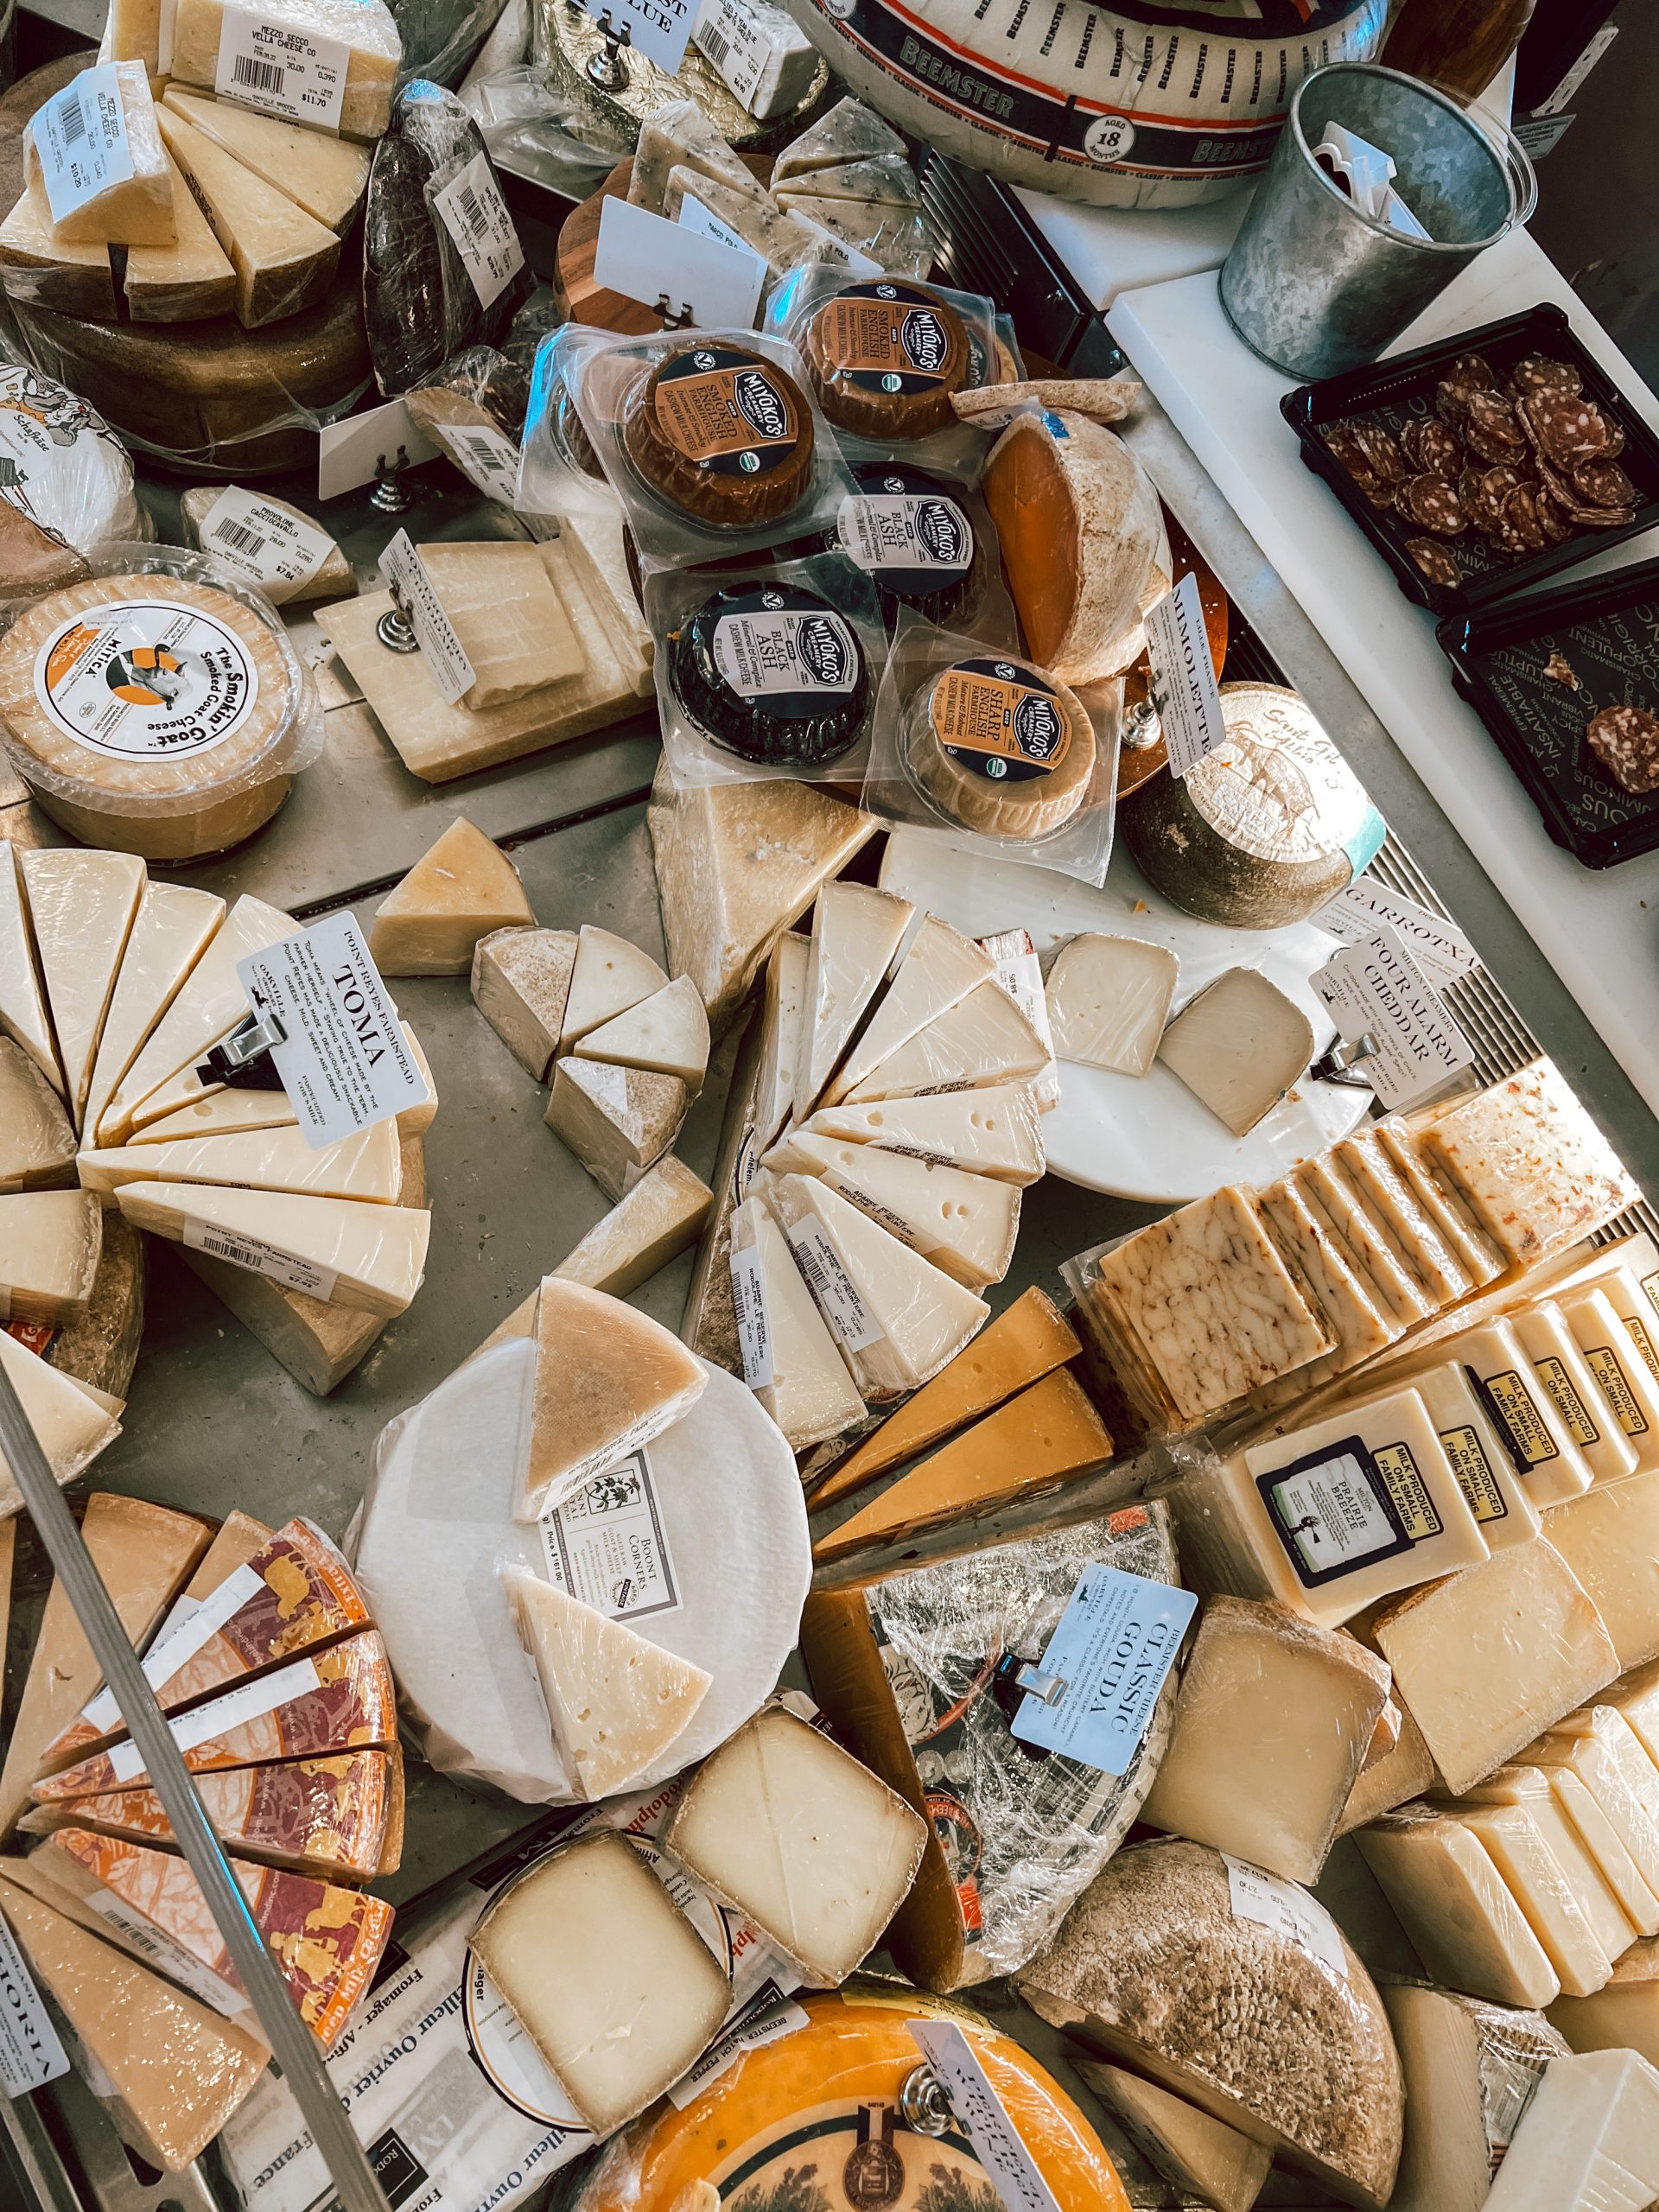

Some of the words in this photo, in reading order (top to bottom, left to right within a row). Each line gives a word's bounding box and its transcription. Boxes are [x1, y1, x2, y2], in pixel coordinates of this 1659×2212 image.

[251, 30, 274, 43] VELLA
[276, 39, 303, 53] CHEESE
[306, 48, 315, 56] CO
[261, 25, 283, 38] MEZZO
[286, 34, 308, 46] SECCO
[1039, 2, 1065, 55] BEEMSTER
[1074, 13, 1096, 68] BEEMSTER
[896, 35, 1018, 120] BEEMSTER
[1158, 35, 1179, 89] BEEMSTER
[1190, 43, 1208, 98] BEEMSTER
[1220, 48, 1236, 103] BEEMSTER
[97, 92, 106, 111] VELLA
[101, 113, 111, 137] CHEESE
[926, 98, 962, 120] BEEMSTER
[1104, 119, 1125, 129] AGED
[1089, 144, 1120, 160] MONTHS
[1097, 132, 1120, 147] 18
[483, 186, 499, 214] SPECIAL
[496, 216, 511, 239] SELECT
[707, 222, 724, 239] MARCO
[833, 247, 850, 261] POLO
[860, 308, 868, 357] FARMHOUSE
[868, 309, 879, 358] ENGLISH
[879, 309, 889, 359] SMOKED
[916, 315, 941, 368] MIYOKO'S
[664, 390, 681, 415] CASHEW
[675, 415, 689, 429] MILK
[688, 388, 716, 442] FARMHOUSE
[696, 385, 727, 439] ENGLISH
[705, 384, 737, 437] SMOKED
[743, 374, 781, 435] MIYOKO'S
[743, 386, 763, 423] CREAMERY
[13, 414, 50, 452] Schafkäse
[250, 507, 298, 538] CACCIOCAVALLO
[261, 505, 295, 529] PROVOLONE
[876, 512, 897, 549] ASH
[889, 511, 909, 550] BLACK
[925, 512, 940, 549] CREAMERY
[928, 504, 956, 559] MIYOKO'S
[401, 540, 469, 671] MONTGOMERY
[408, 567, 454, 657] CHEDDAR
[214, 646, 232, 668] The
[728, 623, 742, 648] CASHEW
[734, 647, 747, 663] MILK
[740, 619, 754, 648] Mineral
[747, 656, 764, 689] Complex
[755, 632, 778, 671] ASH
[769, 629, 790, 672] BLACK
[805, 630, 823, 670] CREAMERY
[810, 620, 840, 680] MIYOKO'S
[1567, 627, 1637, 666] OPULENT
[200, 652, 221, 696] Smoked
[737, 662, 752, 686] CHEESE
[1172, 587, 1211, 754] MIMOLETTE
[1202, 655, 1214, 698] FRANCE
[1579, 646, 1640, 680] CHARISMATIC
[196, 696, 218, 716] Goat
[945, 677, 956, 700] CASHEW
[968, 685, 978, 735] FARMHOUSE
[976, 687, 988, 738] ENGLISH
[1487, 673, 1528, 731] EPHEMERAL
[1541, 692, 1583, 716] VIBRANT
[147, 715, 195, 729] Cheese
[944, 715, 953, 734] CHEESE
[988, 690, 1001, 740] SHARP
[1029, 697, 1055, 756] MIYOKO'S
[1262, 702, 1313, 743] Sant
[1307, 735, 1343, 766] Gil
[1499, 675, 1560, 758] INSATIABLE
[1345, 885, 1478, 968] GARROTXA
[258, 963, 285, 1018] OAKVILLE
[343, 930, 365, 969] POINT
[360, 970, 383, 1011] REYES
[378, 1012, 415, 1085] FARMSTEAD
[1361, 963, 1432, 1062] CHEDDAR
[1368, 936, 1412, 994] FOUR
[1405, 994, 1459, 1068] ALARM
[1399, 950, 1425, 985] MILTON
[1421, 984, 1456, 1034] CREAMERY
[282, 943, 295, 964] POINT
[291, 966, 306, 990] REYES
[302, 992, 312, 1007] HAS
[309, 1008, 321, 1028] MADE
[321, 1037, 344, 1082] DELICIOUSLY
[340, 1084, 362, 1125] SNACKABLE
[293, 942, 308, 970] FARMER
[323, 1014, 339, 1043] STAYING
[335, 1045, 347, 1065] TRUE
[345, 1065, 353, 1076] TO
[349, 1077, 359, 1093] THE
[303, 939, 315, 959] TOMA
[312, 961, 325, 985] MEANS
[336, 1018, 344, 1029] OF
[341, 1030, 357, 1059] CHEESE
[354, 1061, 366, 1081] MADE
[364, 1084, 371, 1092] BY
[368, 1095, 378, 1109] THE
[330, 963, 389, 1069] TOMA
[308, 1031, 321, 1055] SWEET
[319, 1057, 327, 1071] AND
[325, 1072, 341, 1103] CREAMY
[307, 1105, 317, 1125] MILK
[923, 1151, 952, 1161] RESERVE
[853, 1189, 879, 1208] ADARRE
[879, 1206, 908, 1227] RESERVE
[206, 1224, 231, 1236] POINT
[266, 1248, 311, 1270] FARMSTEAD
[824, 1244, 842, 1270] ADARRE
[841, 1273, 861, 1304] RESERVE
[758, 1312, 766, 1344] RESERVE
[1629, 1321, 1644, 1344] MILK
[1547, 1378, 1560, 1395] ON
[1548, 1361, 1566, 1385] MILK
[1560, 1386, 1593, 1440] PRODUCED
[1491, 1386, 1515, 1421] FAMILY
[1510, 1421, 1532, 1455] FARMS
[1505, 1393, 1518, 1408] ON
[1514, 1408, 1536, 1443] SMALL
[1507, 1375, 1524, 1399] MILK
[1520, 1399, 1553, 1454] PRODUCED
[1378, 1459, 1400, 1496] FAMILY
[1394, 1495, 1414, 1532] FARMS
[1392, 1465, 1405, 1484] ON
[1400, 1482, 1420, 1518] SMALL
[1395, 1447, 1413, 1473] MILK
[1407, 1473, 1437, 1530] PRODUCED
[1462, 1430, 1478, 1455] MILK
[1472, 1456, 1502, 1514] PRODUCED
[1331, 1485, 1357, 1530] BREEZE
[1338, 1480, 1367, 1529] PRAIRIE
[626, 1534, 652, 1590] CORNERS
[639, 1538, 660, 1580] BOONT
[1088, 1618, 1143, 1719] GOUDA
[1109, 1618, 1170, 1735] CLASSIC
[1148, 1627, 1179, 1690] BEEMSTER
[1128, 1689, 1154, 1737] CHEESE
[360, 1967, 424, 2025] Fromager
[747, 2016, 786, 2039] BEEMSTER
[350, 2031, 419, 2100] Ouvrier
[690, 2056, 720, 2082] PEPPER
[252, 2130, 316, 2190] France
[963, 2101, 1007, 2174] WINE
[966, 2073, 1044, 2204] PERFECT
